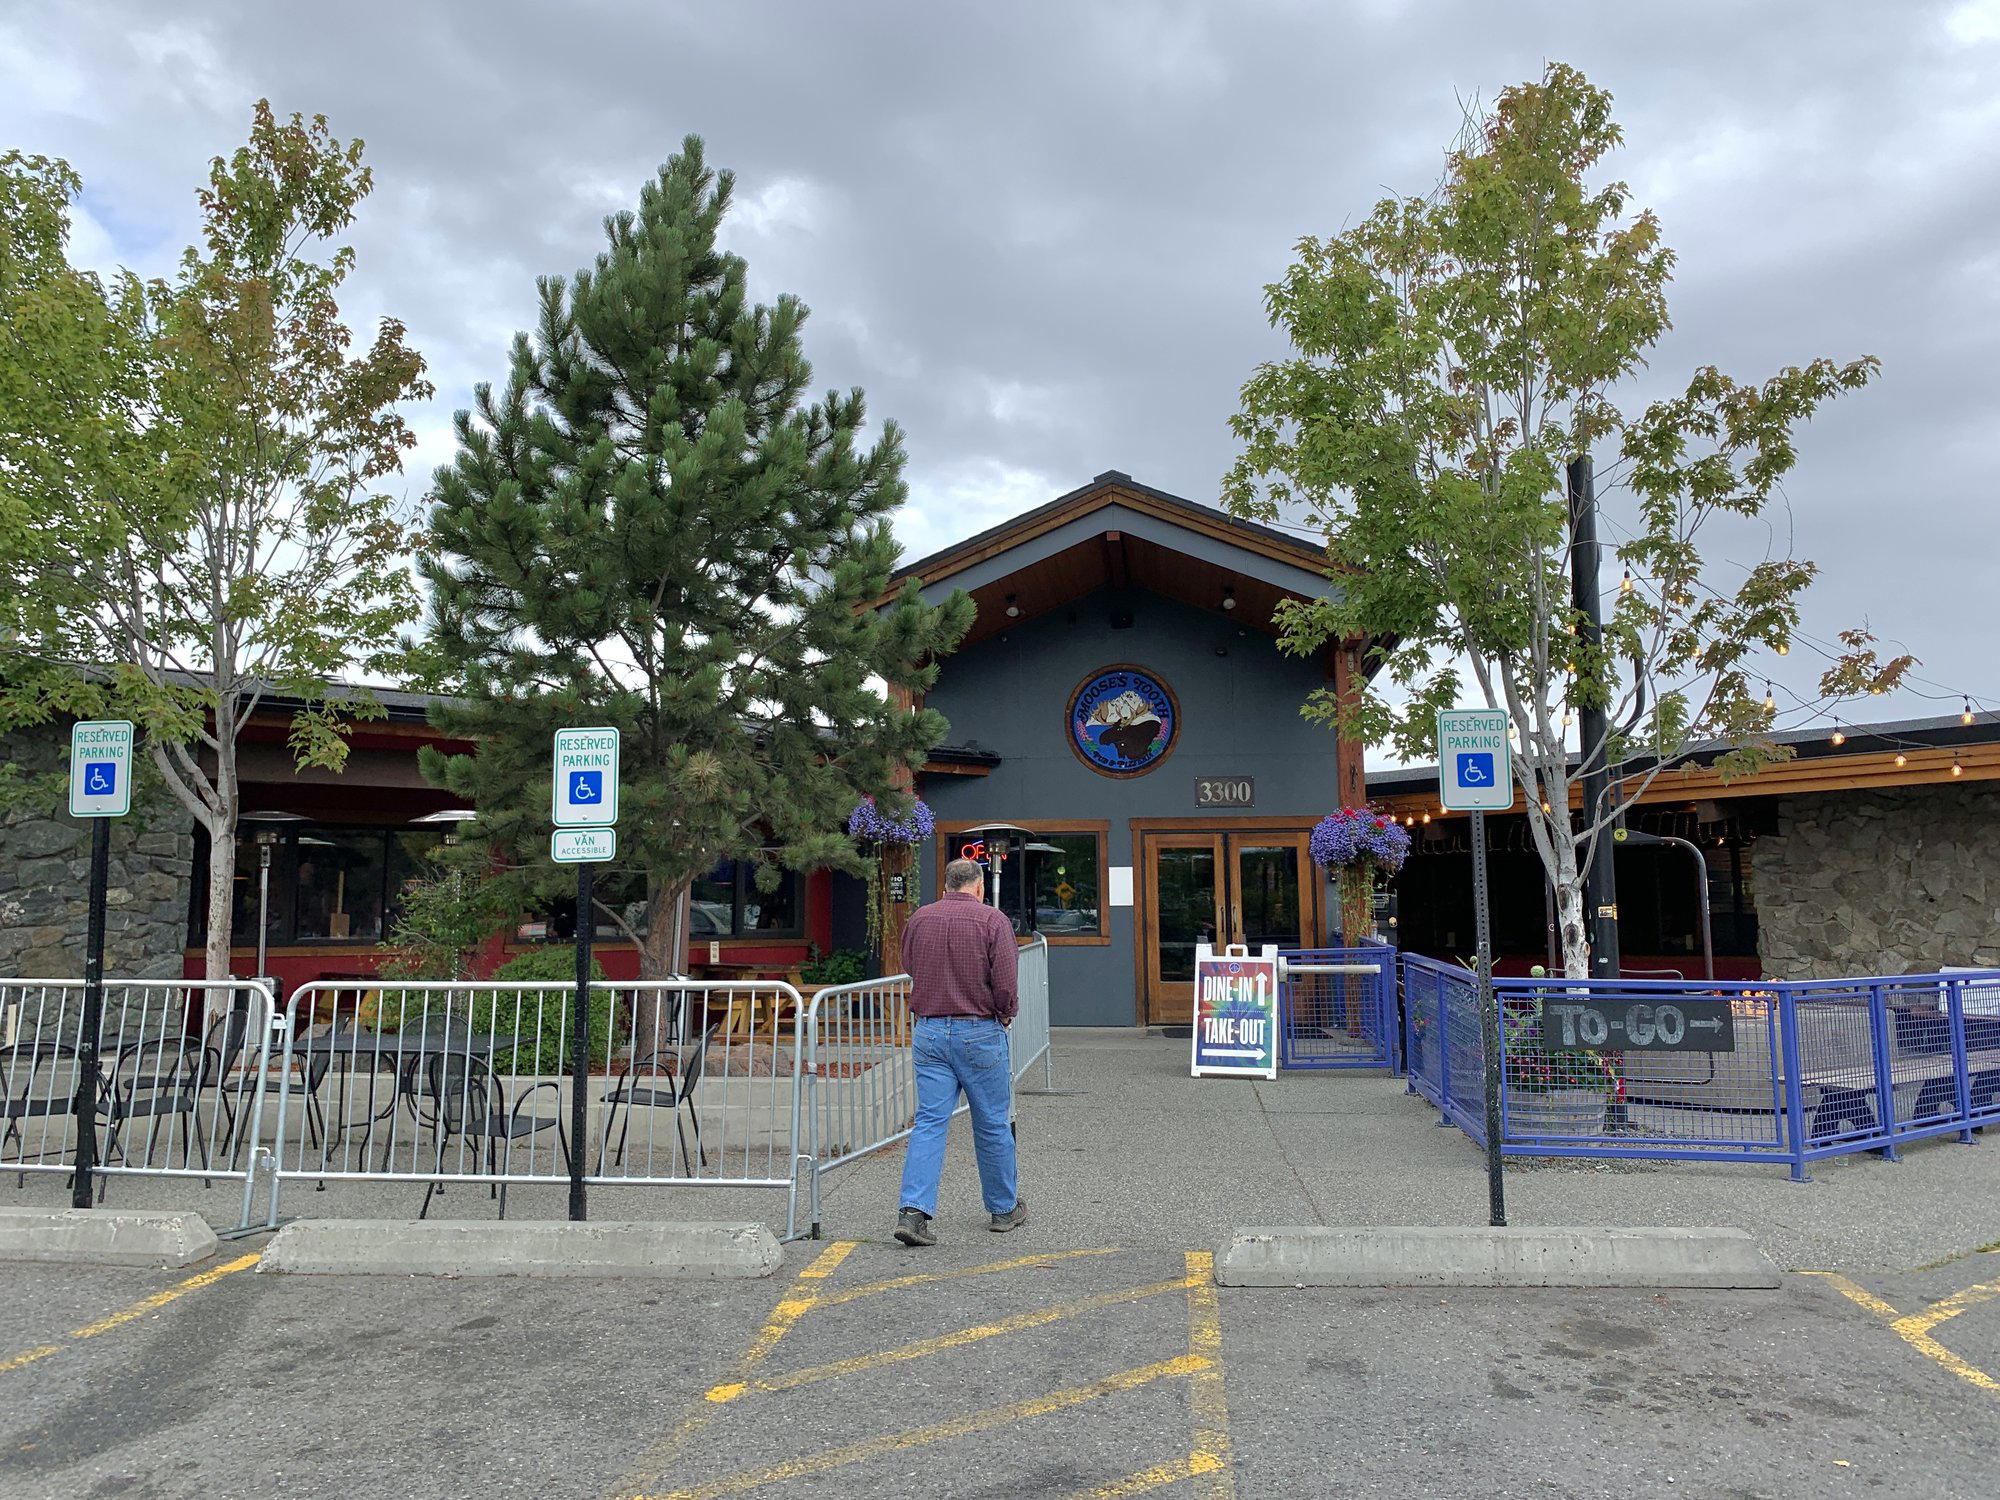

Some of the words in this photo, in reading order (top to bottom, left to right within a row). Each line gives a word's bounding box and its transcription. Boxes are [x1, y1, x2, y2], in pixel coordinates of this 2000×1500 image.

[1133, 677, 1170, 719] TOOTH
[1443, 719, 1504, 732] RESERVED
[77, 730, 129, 743] RESERVED
[1447, 735, 1501, 749] PARKING
[559, 737, 615, 751] RESERVED
[79, 745, 124, 759] PARKING
[562, 753, 610, 767] PARKING
[1200, 781, 1251, 803] 3300
[574, 835, 596, 846] VAN
[561, 846, 607, 855] ACCESSIBLE
[1203, 975, 1253, 1002] DINE-IN
[1203, 1017, 1266, 1046] TAKE-OUT
[1549, 1004, 1685, 1046] TO-GO
